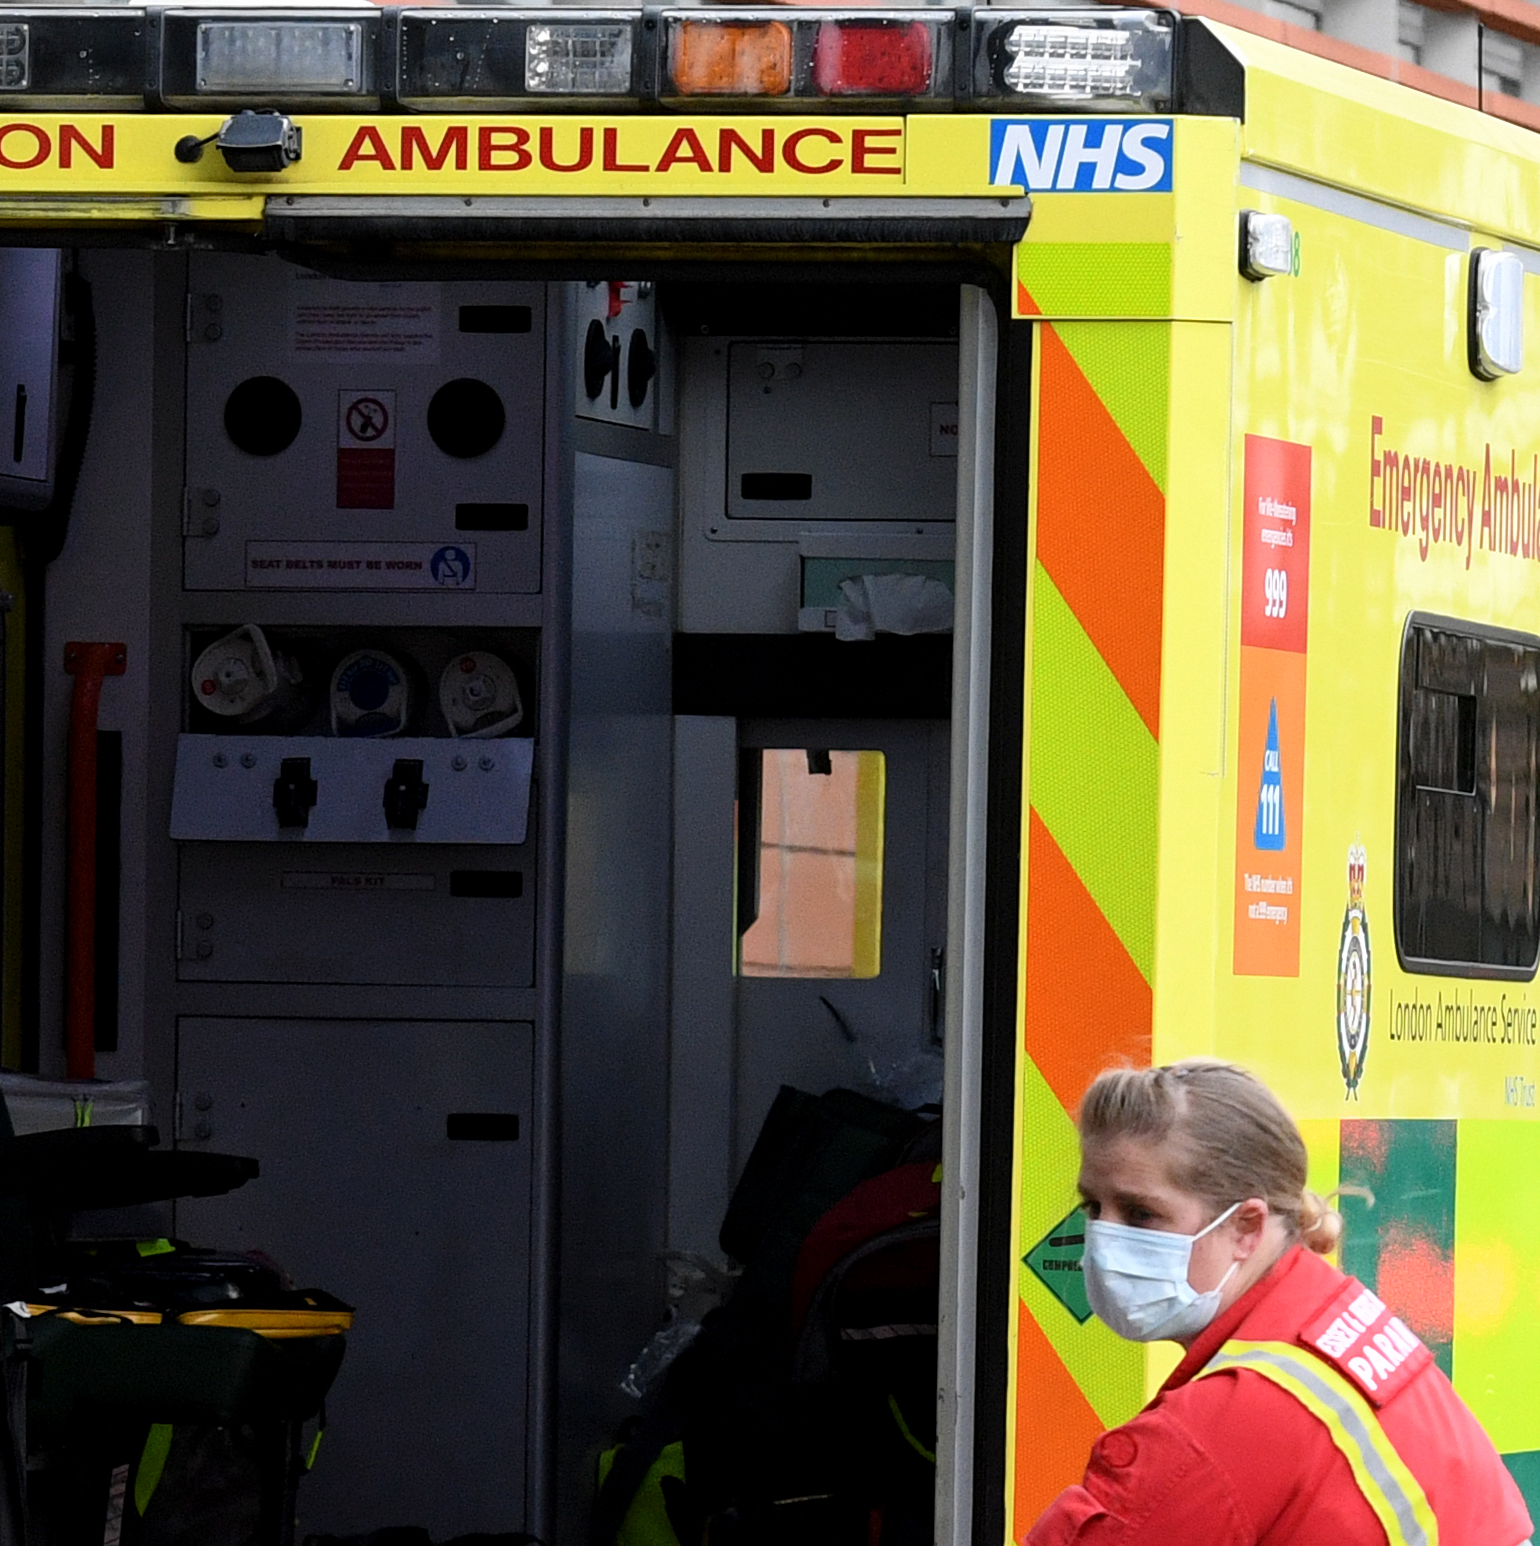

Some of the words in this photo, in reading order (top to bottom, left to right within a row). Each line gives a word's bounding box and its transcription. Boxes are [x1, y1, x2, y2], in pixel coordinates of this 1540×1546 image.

[337, 125, 903, 175] AMBULANCE
[993, 123, 1172, 190] NHS
[1370, 414, 1477, 571] Emergency
[1265, 568, 1288, 619] 999
[1264, 749, 1280, 773] CALL
[1261, 783, 1280, 836] 111
[1389, 986, 1433, 1042] London
[1436, 987, 1497, 1045] Ambulance
[1500, 992, 1537, 1046] Service
